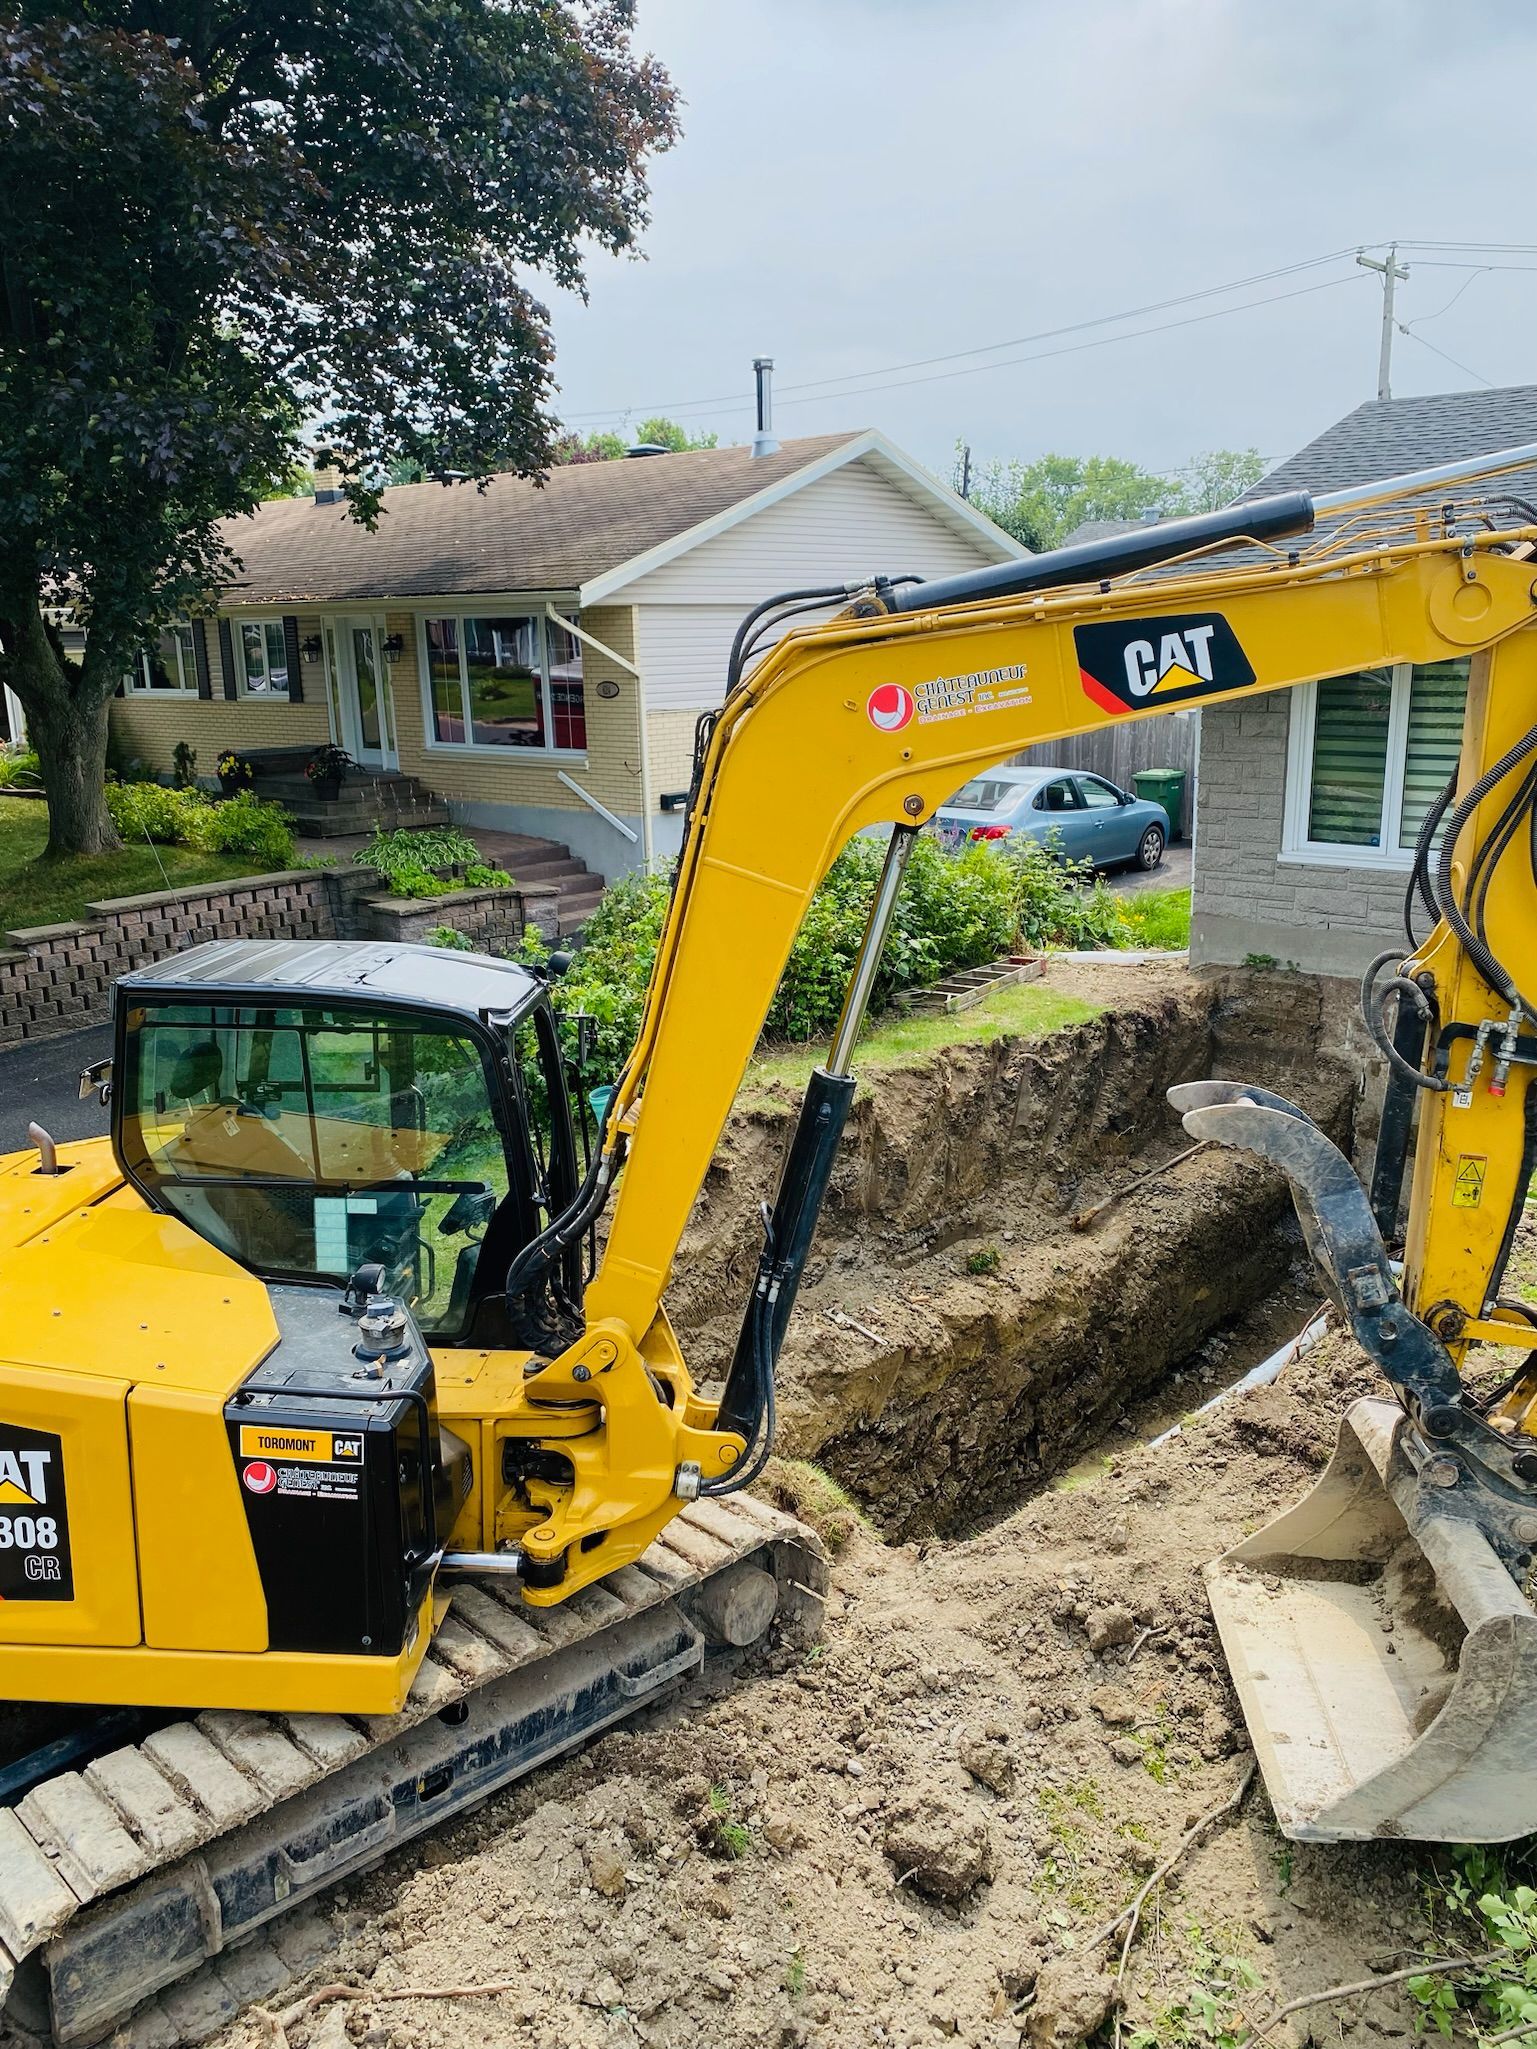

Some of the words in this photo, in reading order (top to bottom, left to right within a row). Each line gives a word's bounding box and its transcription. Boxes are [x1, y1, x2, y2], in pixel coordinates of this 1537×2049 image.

[1123, 624, 1215, 697] CAT
[915, 664, 1027, 698] CHÂTEAUNEUF
[917, 690, 975, 714] GENEST
[258, 1436, 316, 1452] TOROMONT
[334, 1440, 361, 1456] CAT
[0, 1516, 58, 1549] 308
[24, 1554, 61, 1580] CR
